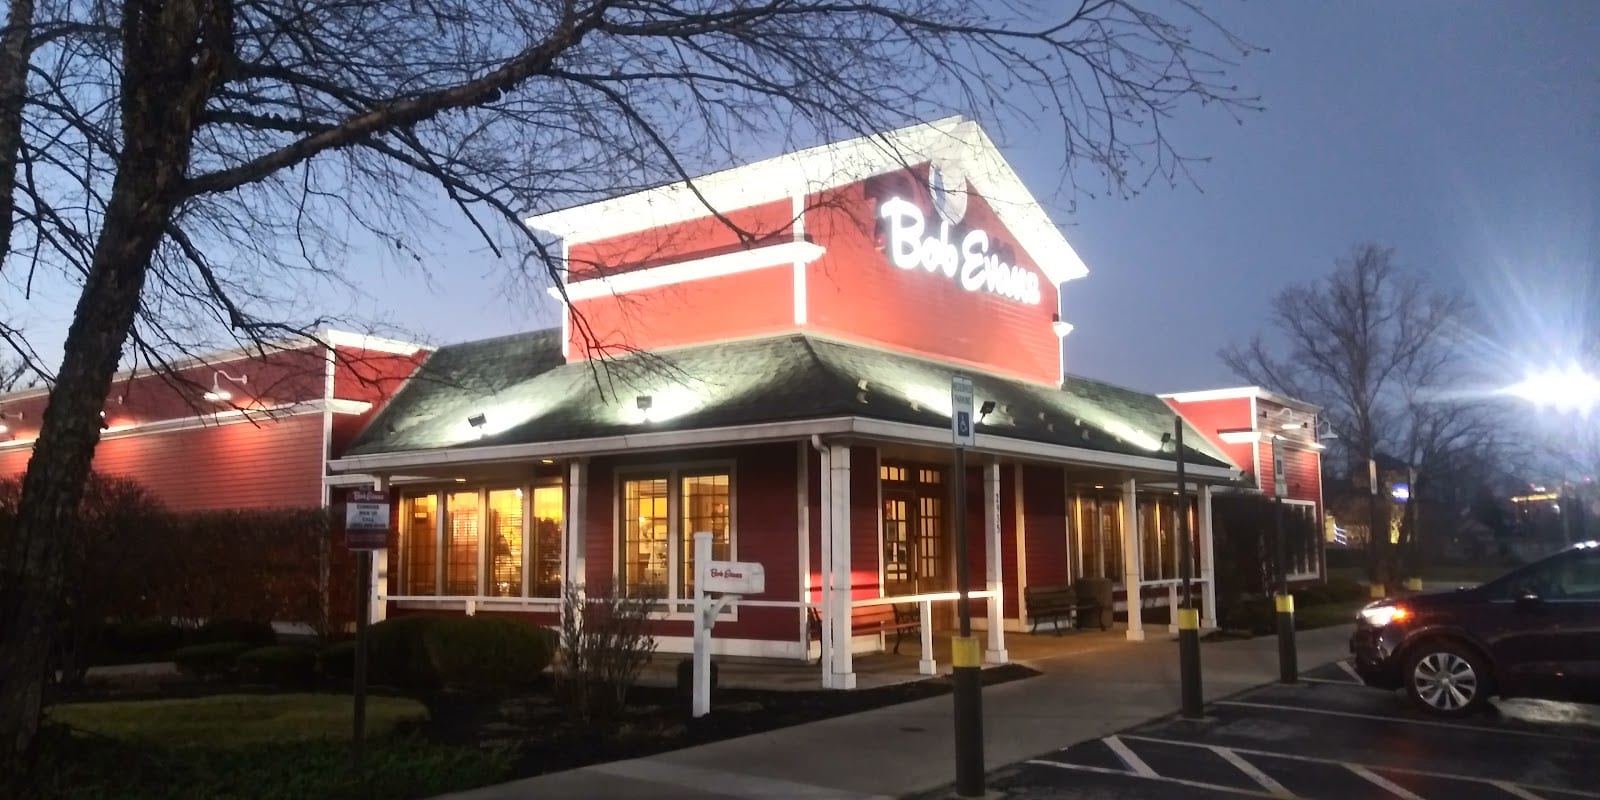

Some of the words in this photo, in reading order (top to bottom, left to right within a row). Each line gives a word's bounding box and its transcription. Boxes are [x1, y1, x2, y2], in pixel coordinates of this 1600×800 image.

[881, 197, 958, 278] Bob
[961, 229, 1041, 305] Evans
[353, 491, 365, 500] Bob
[710, 568, 723, 578] Bob
